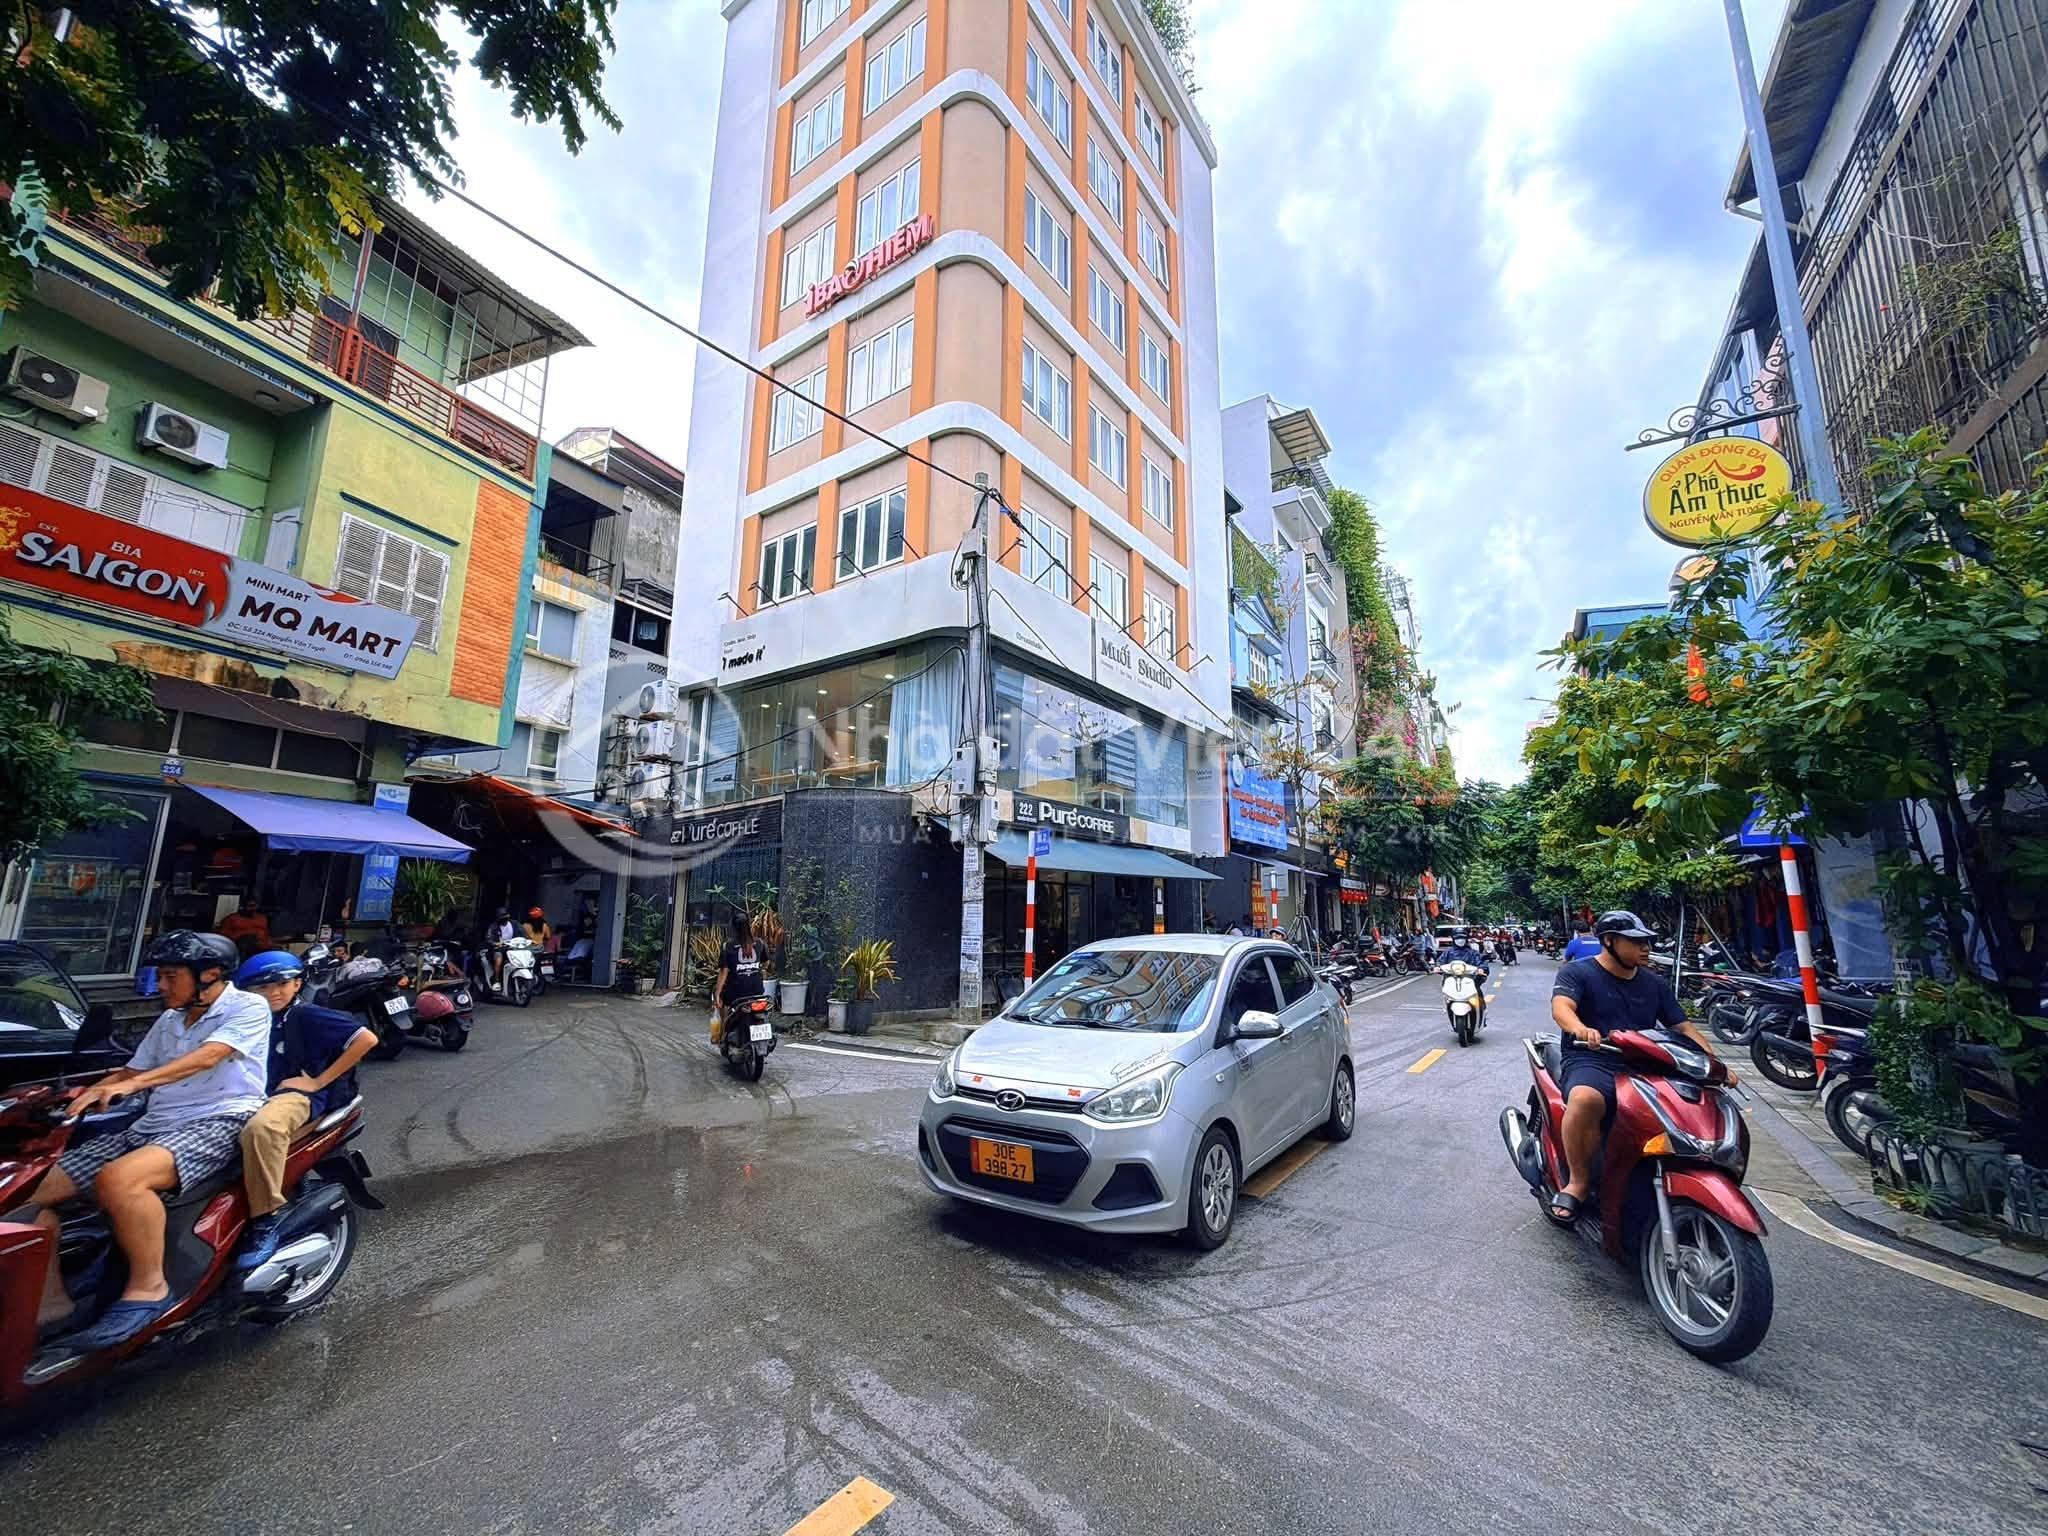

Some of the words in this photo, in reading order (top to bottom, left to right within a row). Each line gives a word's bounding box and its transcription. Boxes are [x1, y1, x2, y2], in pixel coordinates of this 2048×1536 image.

[1685, 471, 1718, 494] Phố
[1669, 480, 1707, 516] Ẩm
[1716, 483, 1767, 512] thực
[112, 541, 142, 558] BIA
[16, 532, 206, 606] SAIGON
[246, 577, 274, 592] MINI
[276, 586, 311, 602] MART
[238, 595, 302, 631] MQ
[308, 616, 401, 658] MART
[728, 651, 754, 669] made
[1100, 637, 1132, 669] Muối
[1138, 658, 1172, 690] Studio
[1019, 803, 1033, 816] 222
[1078, 815, 1115, 834] COFFEE
[993, 1144, 1016, 1161] 30E
